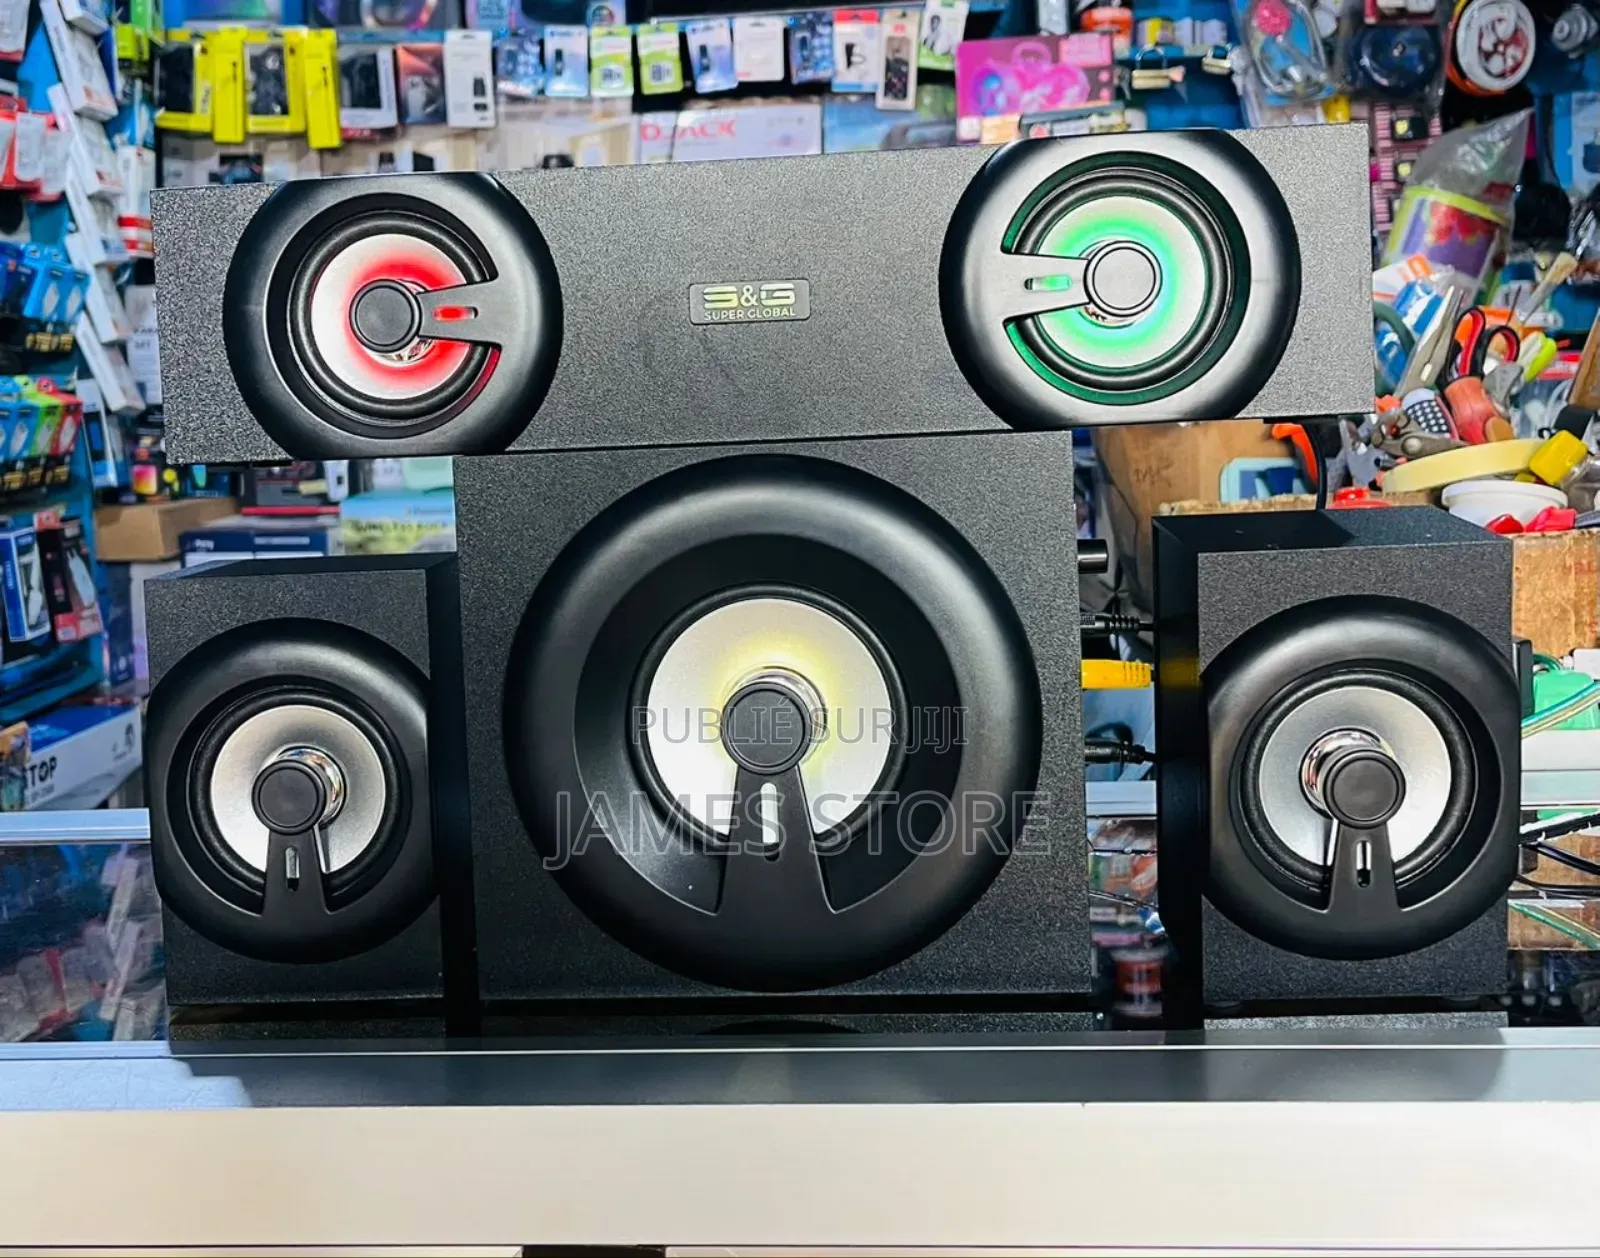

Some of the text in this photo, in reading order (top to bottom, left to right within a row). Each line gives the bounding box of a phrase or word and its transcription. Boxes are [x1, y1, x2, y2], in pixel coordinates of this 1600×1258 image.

[703, 283, 796, 309] S&G
[704, 307, 796, 321] SUPER GLOBAL
